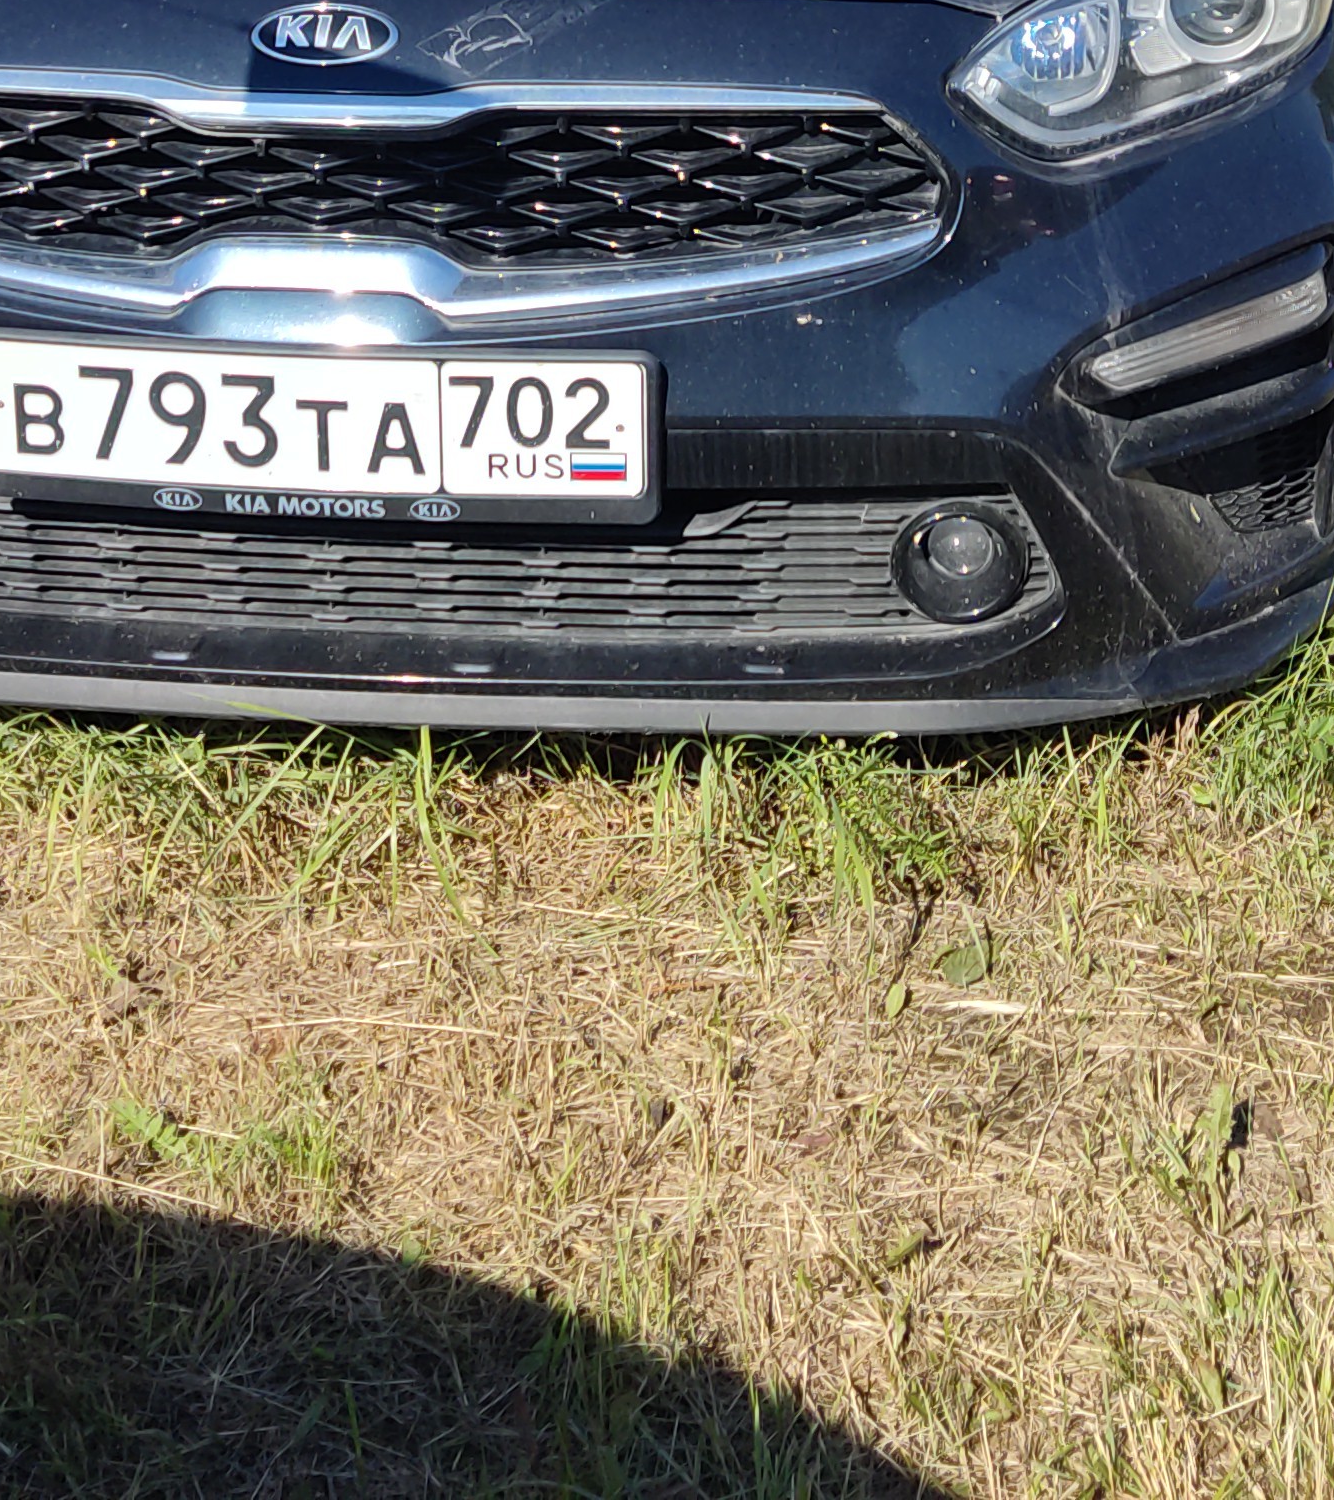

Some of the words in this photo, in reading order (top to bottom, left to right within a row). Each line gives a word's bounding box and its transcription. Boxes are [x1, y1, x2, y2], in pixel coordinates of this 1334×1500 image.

[275, 14, 372, 51] KIA
[448, 375, 611, 450] 702
[488, 453, 565, 480] RUS
[161, 492, 195, 507] KIA
[225, 493, 272, 514] KIA
[277, 496, 387, 519] MOTORS
[418, 503, 453, 518] KIA
